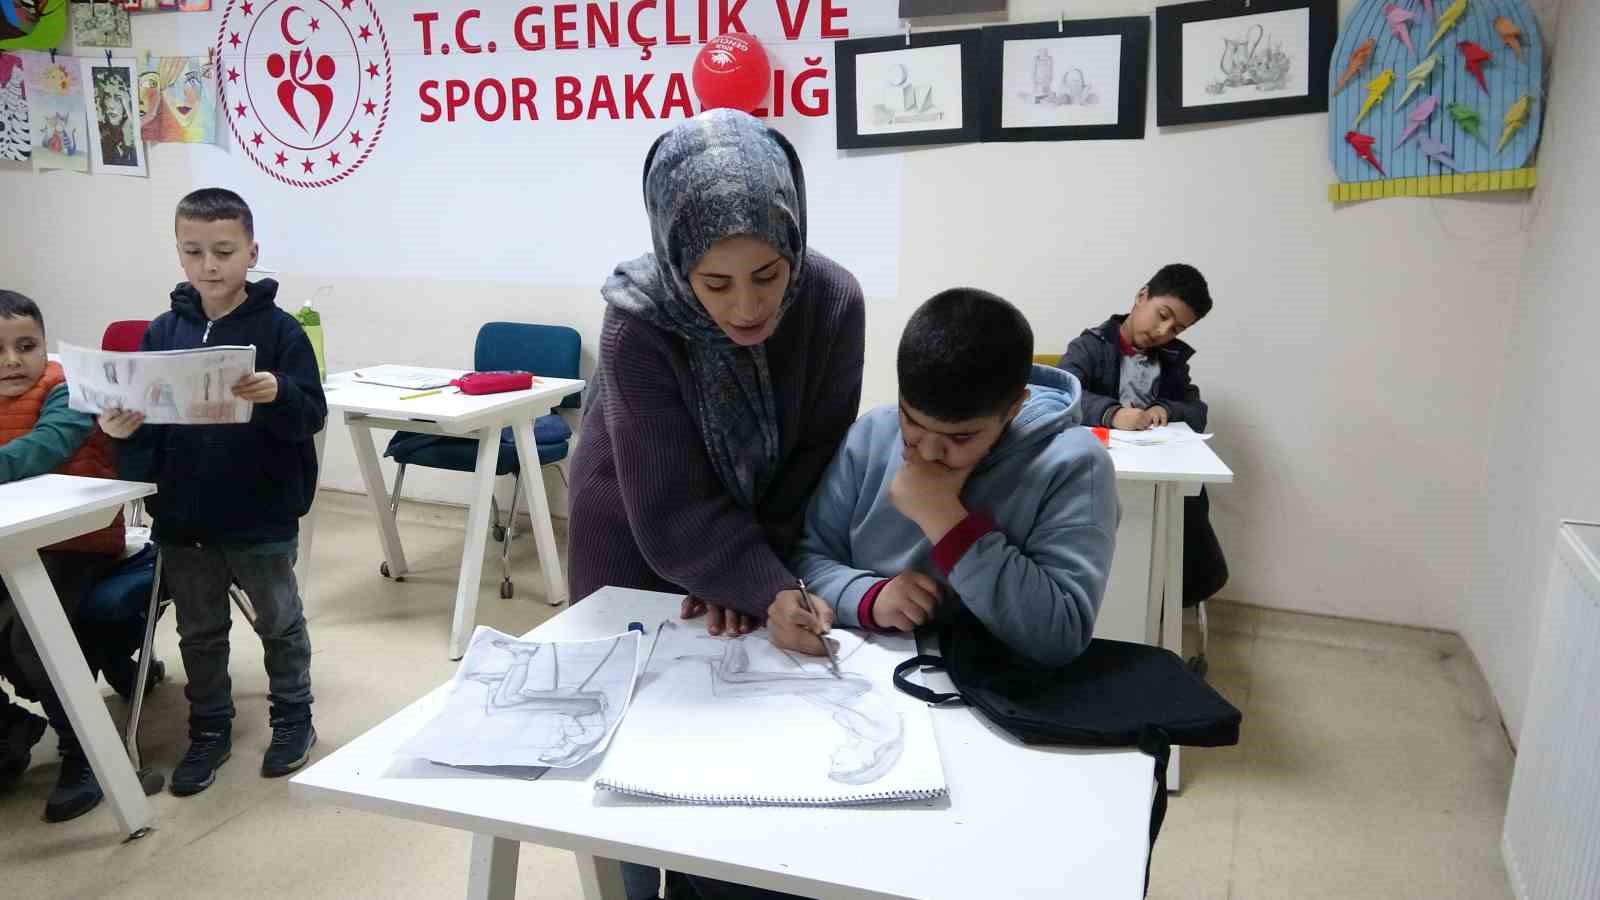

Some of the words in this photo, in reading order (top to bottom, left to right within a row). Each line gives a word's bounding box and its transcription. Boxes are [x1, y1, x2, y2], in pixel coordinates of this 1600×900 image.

[413, 10, 497, 55] T.C.
[775, 0, 849, 41] VE
[419, 78, 539, 124] SPOR
